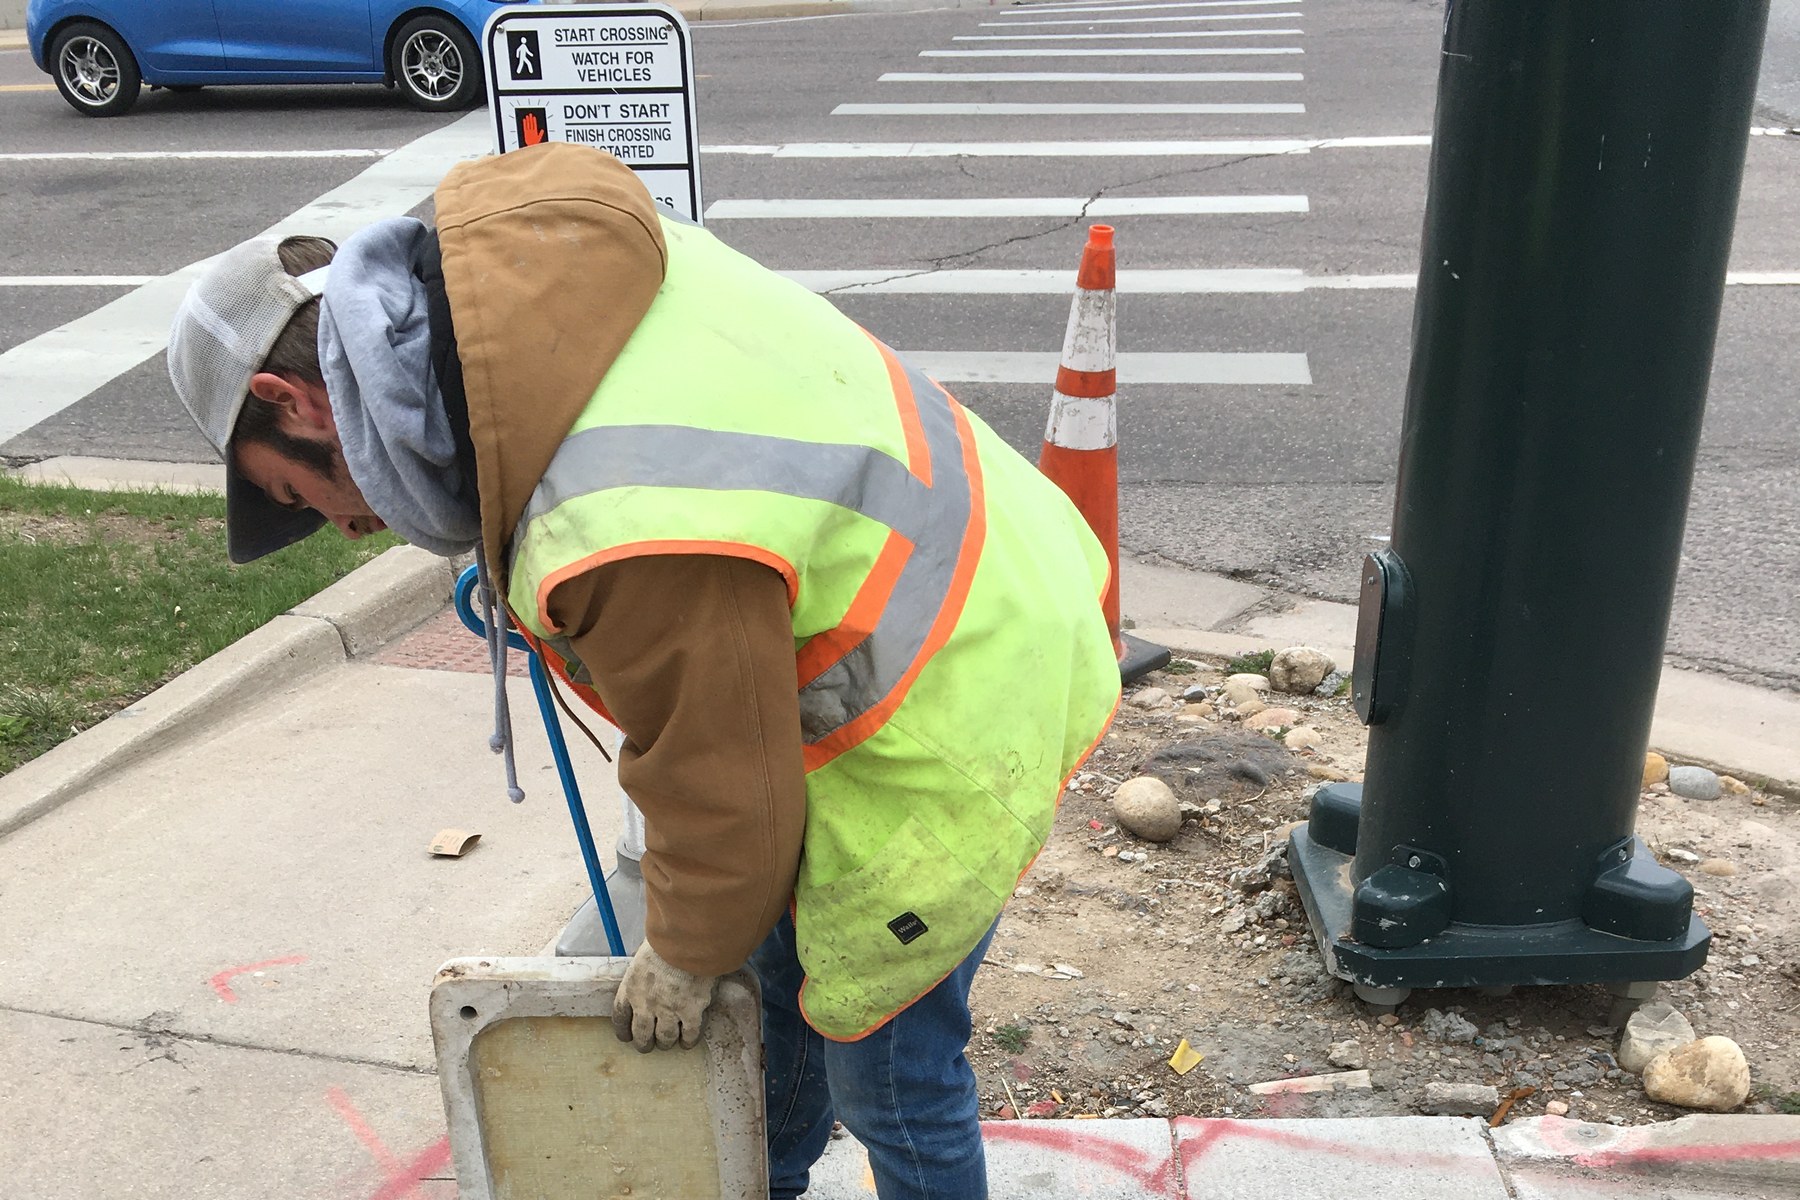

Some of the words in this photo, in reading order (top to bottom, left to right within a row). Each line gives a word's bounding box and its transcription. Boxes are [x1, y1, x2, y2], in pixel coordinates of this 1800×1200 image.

[555, 28, 596, 42] START
[600, 26, 668, 41] CROSSING
[571, 52, 620, 66] WATCH
[626, 51, 654, 64] FOR
[577, 68, 652, 82] VEHICLES
[563, 105, 611, 119] DON'T
[619, 104, 669, 118] START
[565, 129, 605, 142] FINISH
[608, 128, 671, 141] CROSSING
